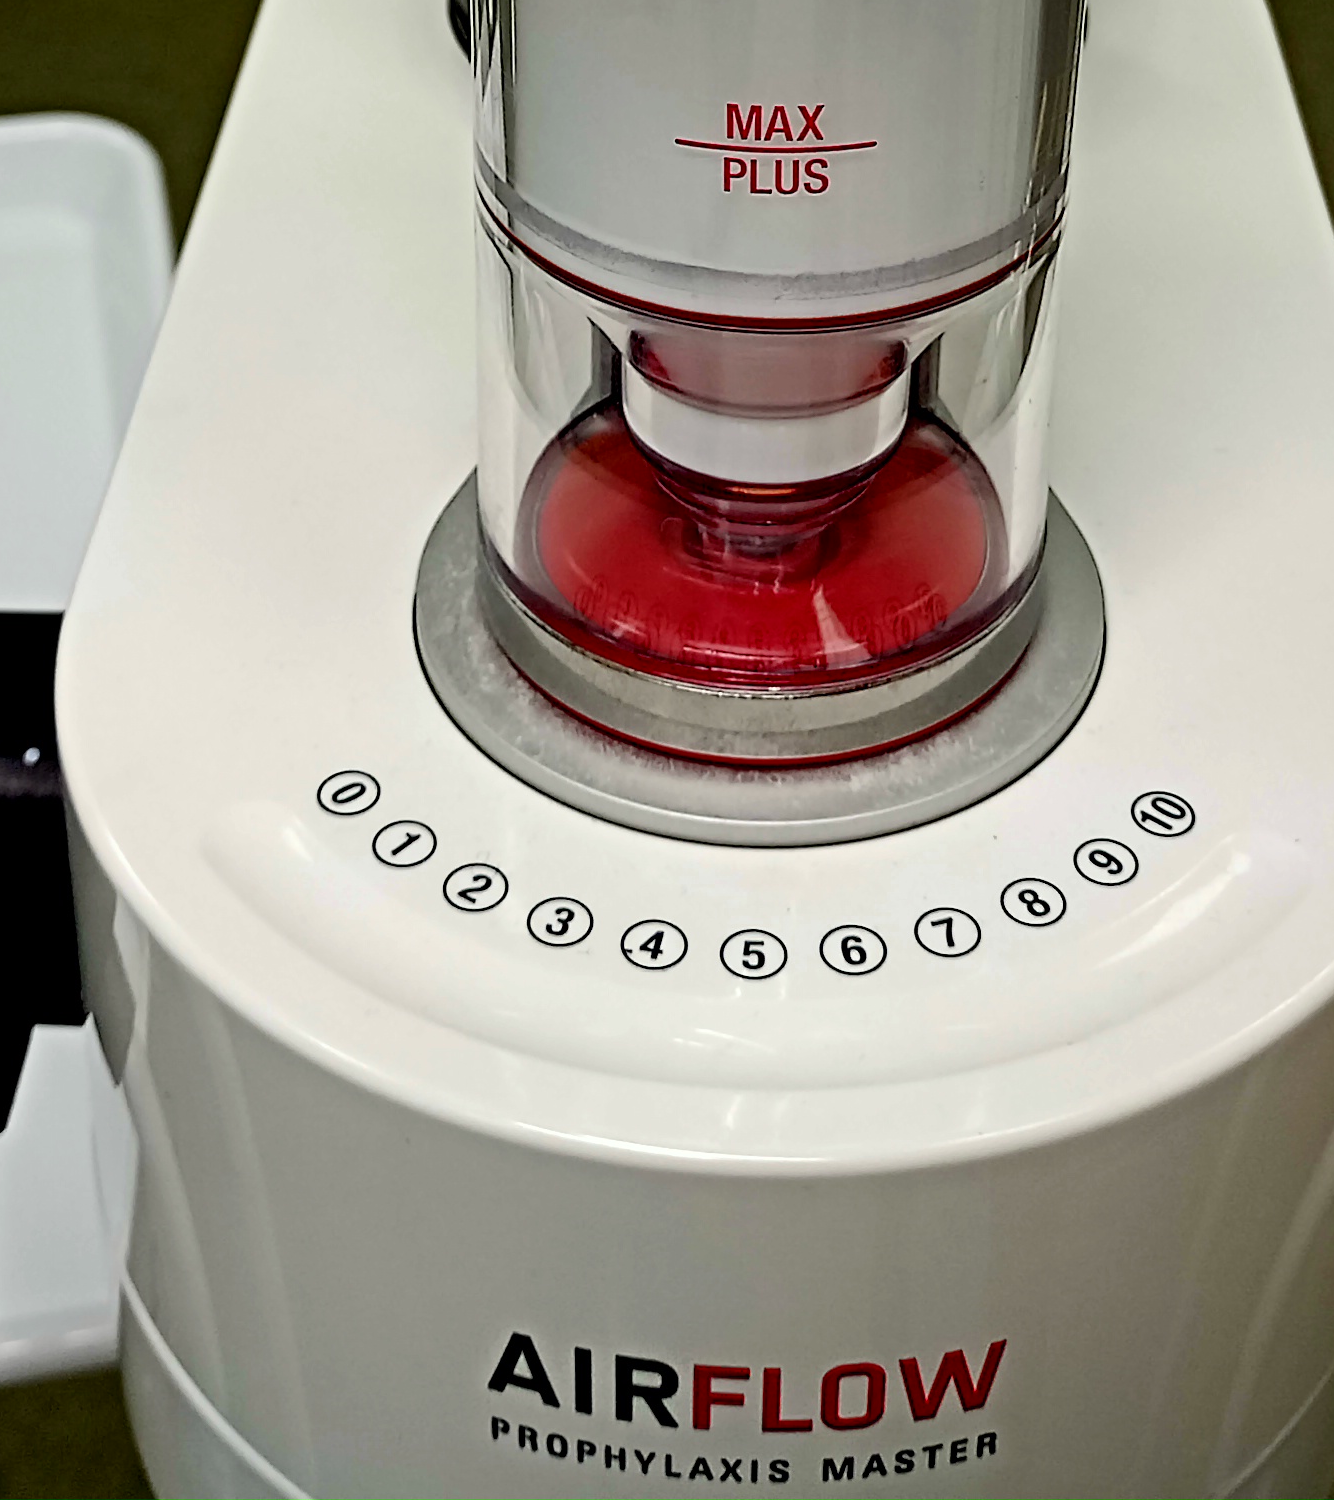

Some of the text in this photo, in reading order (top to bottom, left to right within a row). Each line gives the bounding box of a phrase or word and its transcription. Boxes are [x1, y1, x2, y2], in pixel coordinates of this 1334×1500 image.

[725, 103, 826, 142] MAX
[722, 157, 830, 195] PLUS
[331, 781, 1188, 970] 0 1 2 3 4 5 6 7 8 9 10
[487, 1331, 1008, 1433] AIRFLOW
[490, 1415, 999, 1484] PROPHYLAXIS MASTER
